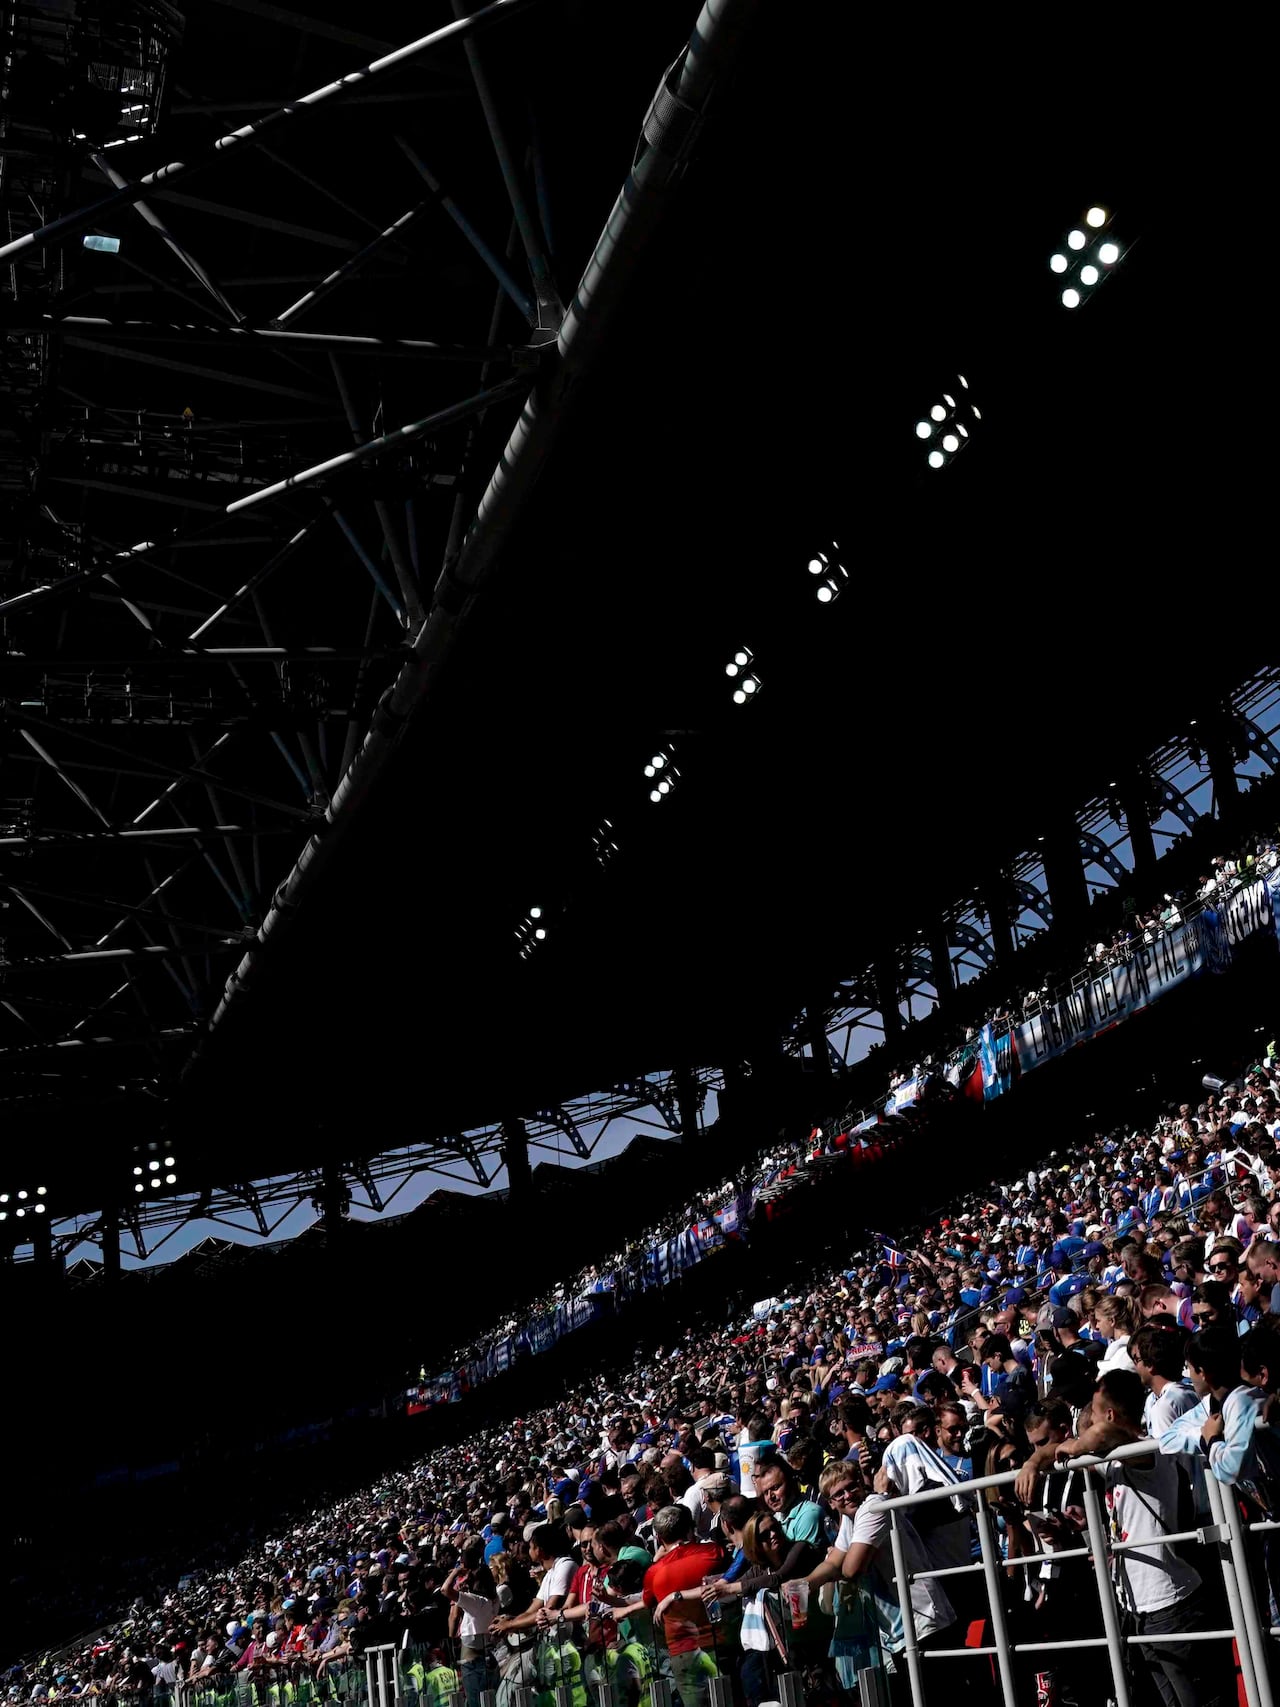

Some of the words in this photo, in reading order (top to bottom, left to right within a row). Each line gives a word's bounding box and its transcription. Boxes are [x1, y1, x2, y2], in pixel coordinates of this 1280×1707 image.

[1029, 1012, 1049, 1058] LA
[1050, 980, 1097, 1050] BANDA
[1092, 971, 1127, 1022] DEL
[1121, 933, 1186, 1003] TAPIAL
